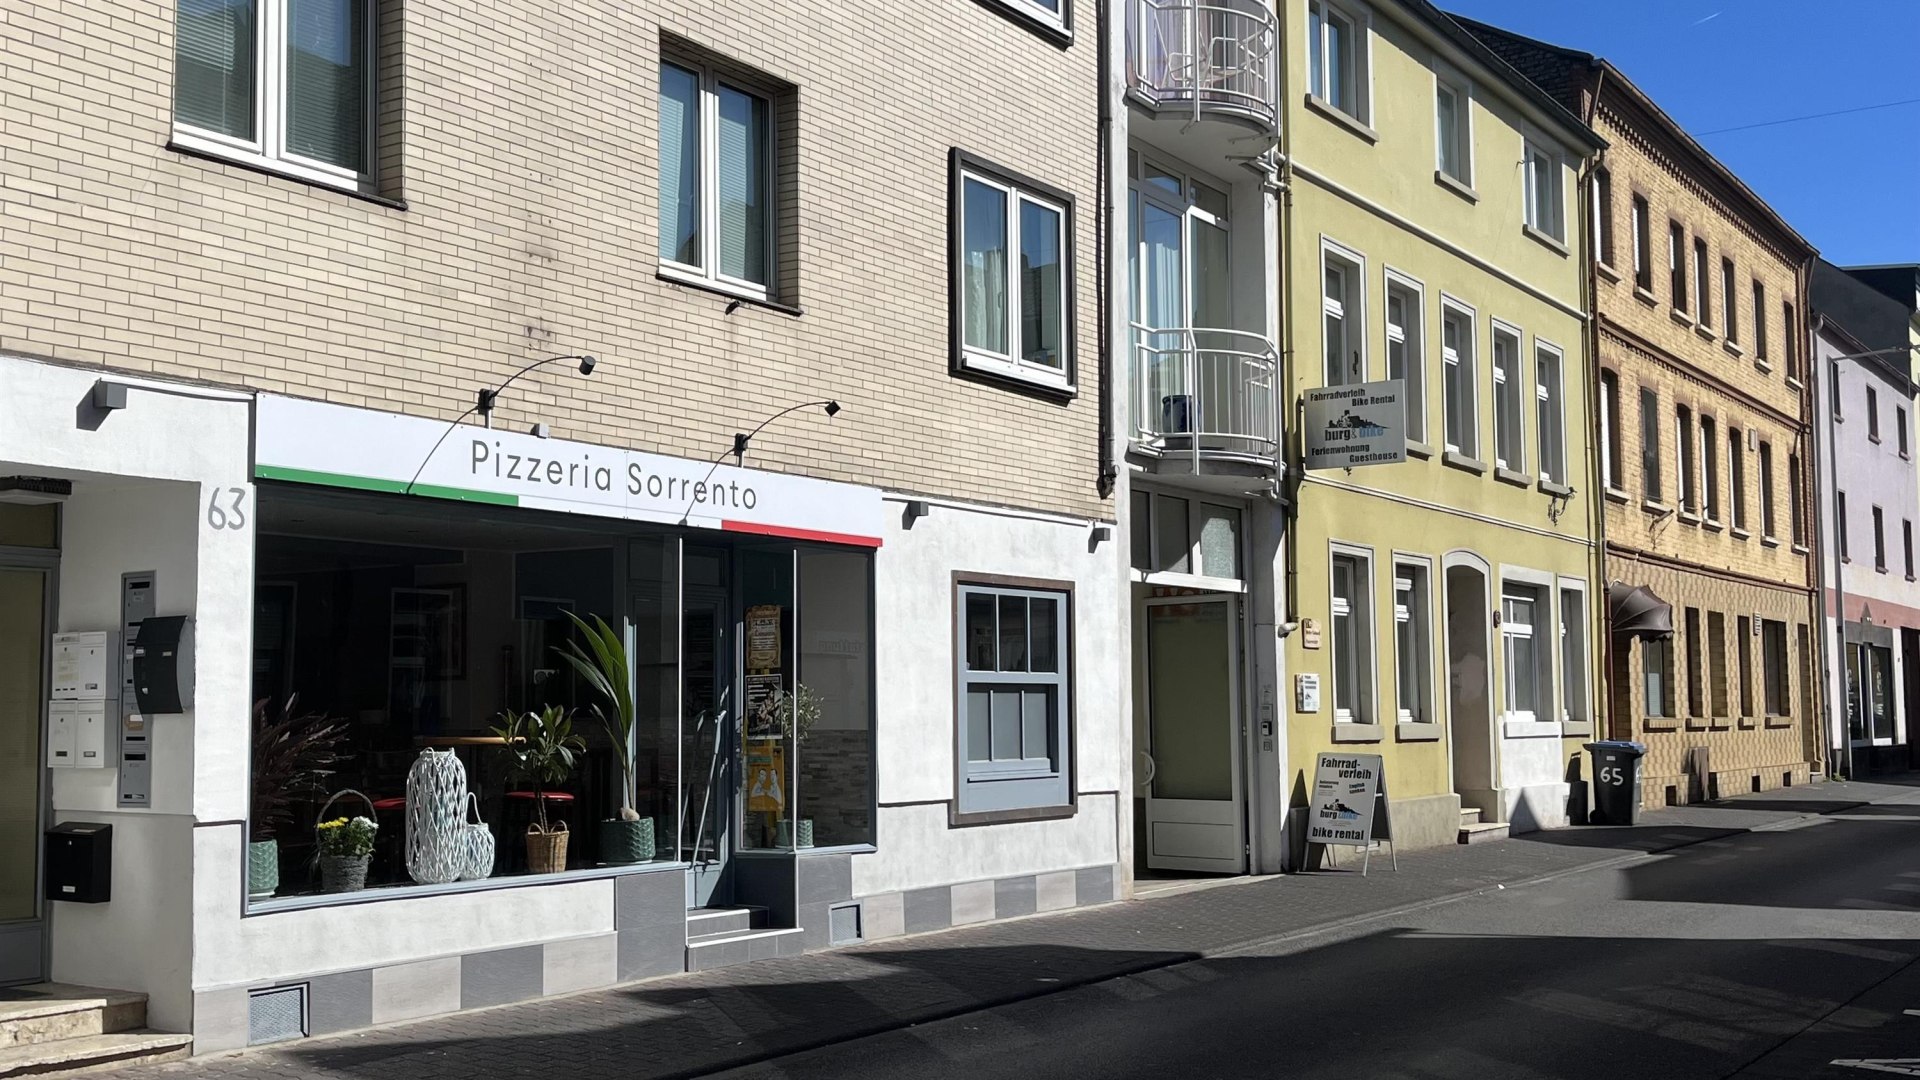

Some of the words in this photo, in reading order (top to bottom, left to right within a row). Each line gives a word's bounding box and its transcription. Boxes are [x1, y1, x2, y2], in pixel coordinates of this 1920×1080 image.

[1310, 389, 1366, 402] Fahrradverleih
[1371, 394, 1395, 404] Rental
[1325, 429, 1351, 441] burg
[1311, 444, 1370, 456] Ferienwohnung
[1350, 452, 1398, 462] Guesthouse
[470, 439, 612, 492] Pizzeria
[627, 462, 757, 510] Sorrento
[208, 488, 245, 530] 63
[1322, 758, 1360, 769] Fahrrad-
[1339, 769, 1371, 779] verleih
[1600, 767, 1624, 786] 65
[1320, 809, 1338, 820] burg
[1312, 826, 1333, 838] bike
[1335, 830, 1364, 840] rental
